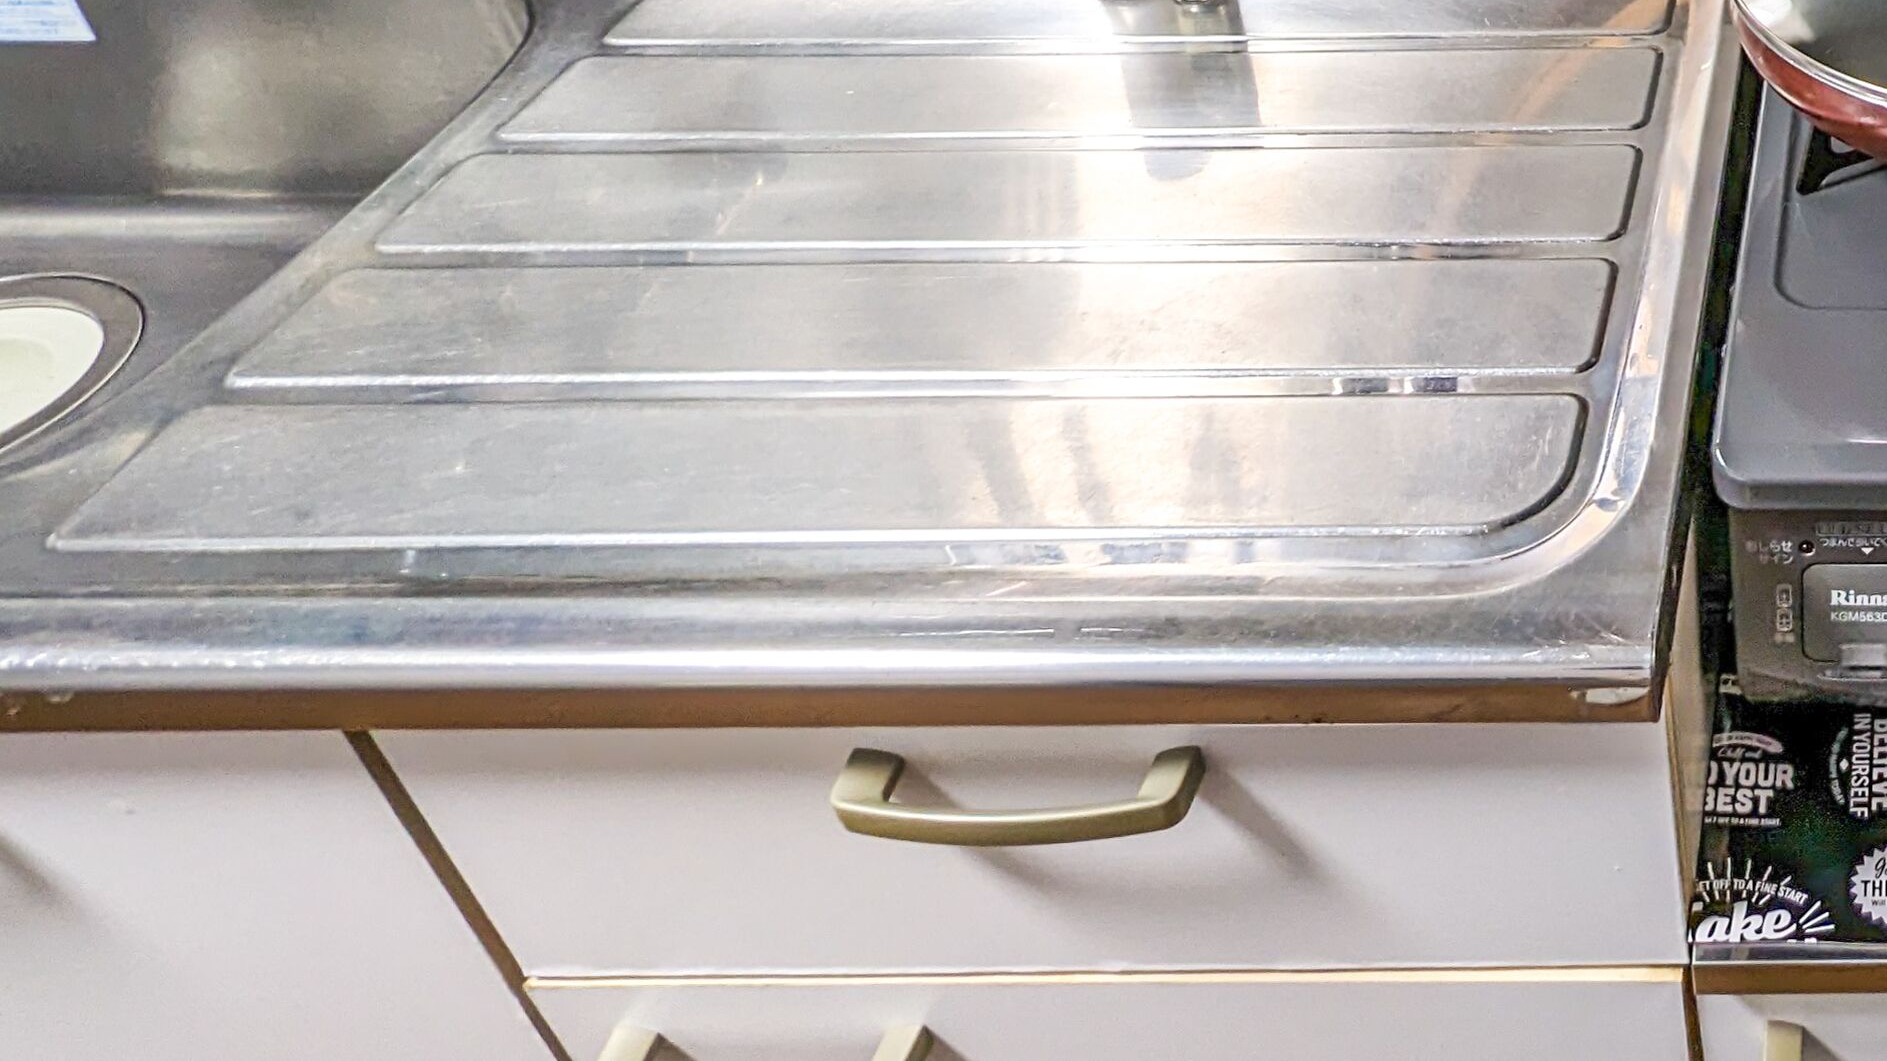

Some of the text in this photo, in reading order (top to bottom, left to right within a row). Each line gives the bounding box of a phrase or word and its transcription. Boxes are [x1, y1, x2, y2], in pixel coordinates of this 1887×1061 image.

[1721, 761, 1795, 788] YOUR
[1849, 732, 1871, 820] YOURSELF
[1777, 886, 1809, 905] START
[1687, 900, 1797, 943] ake
